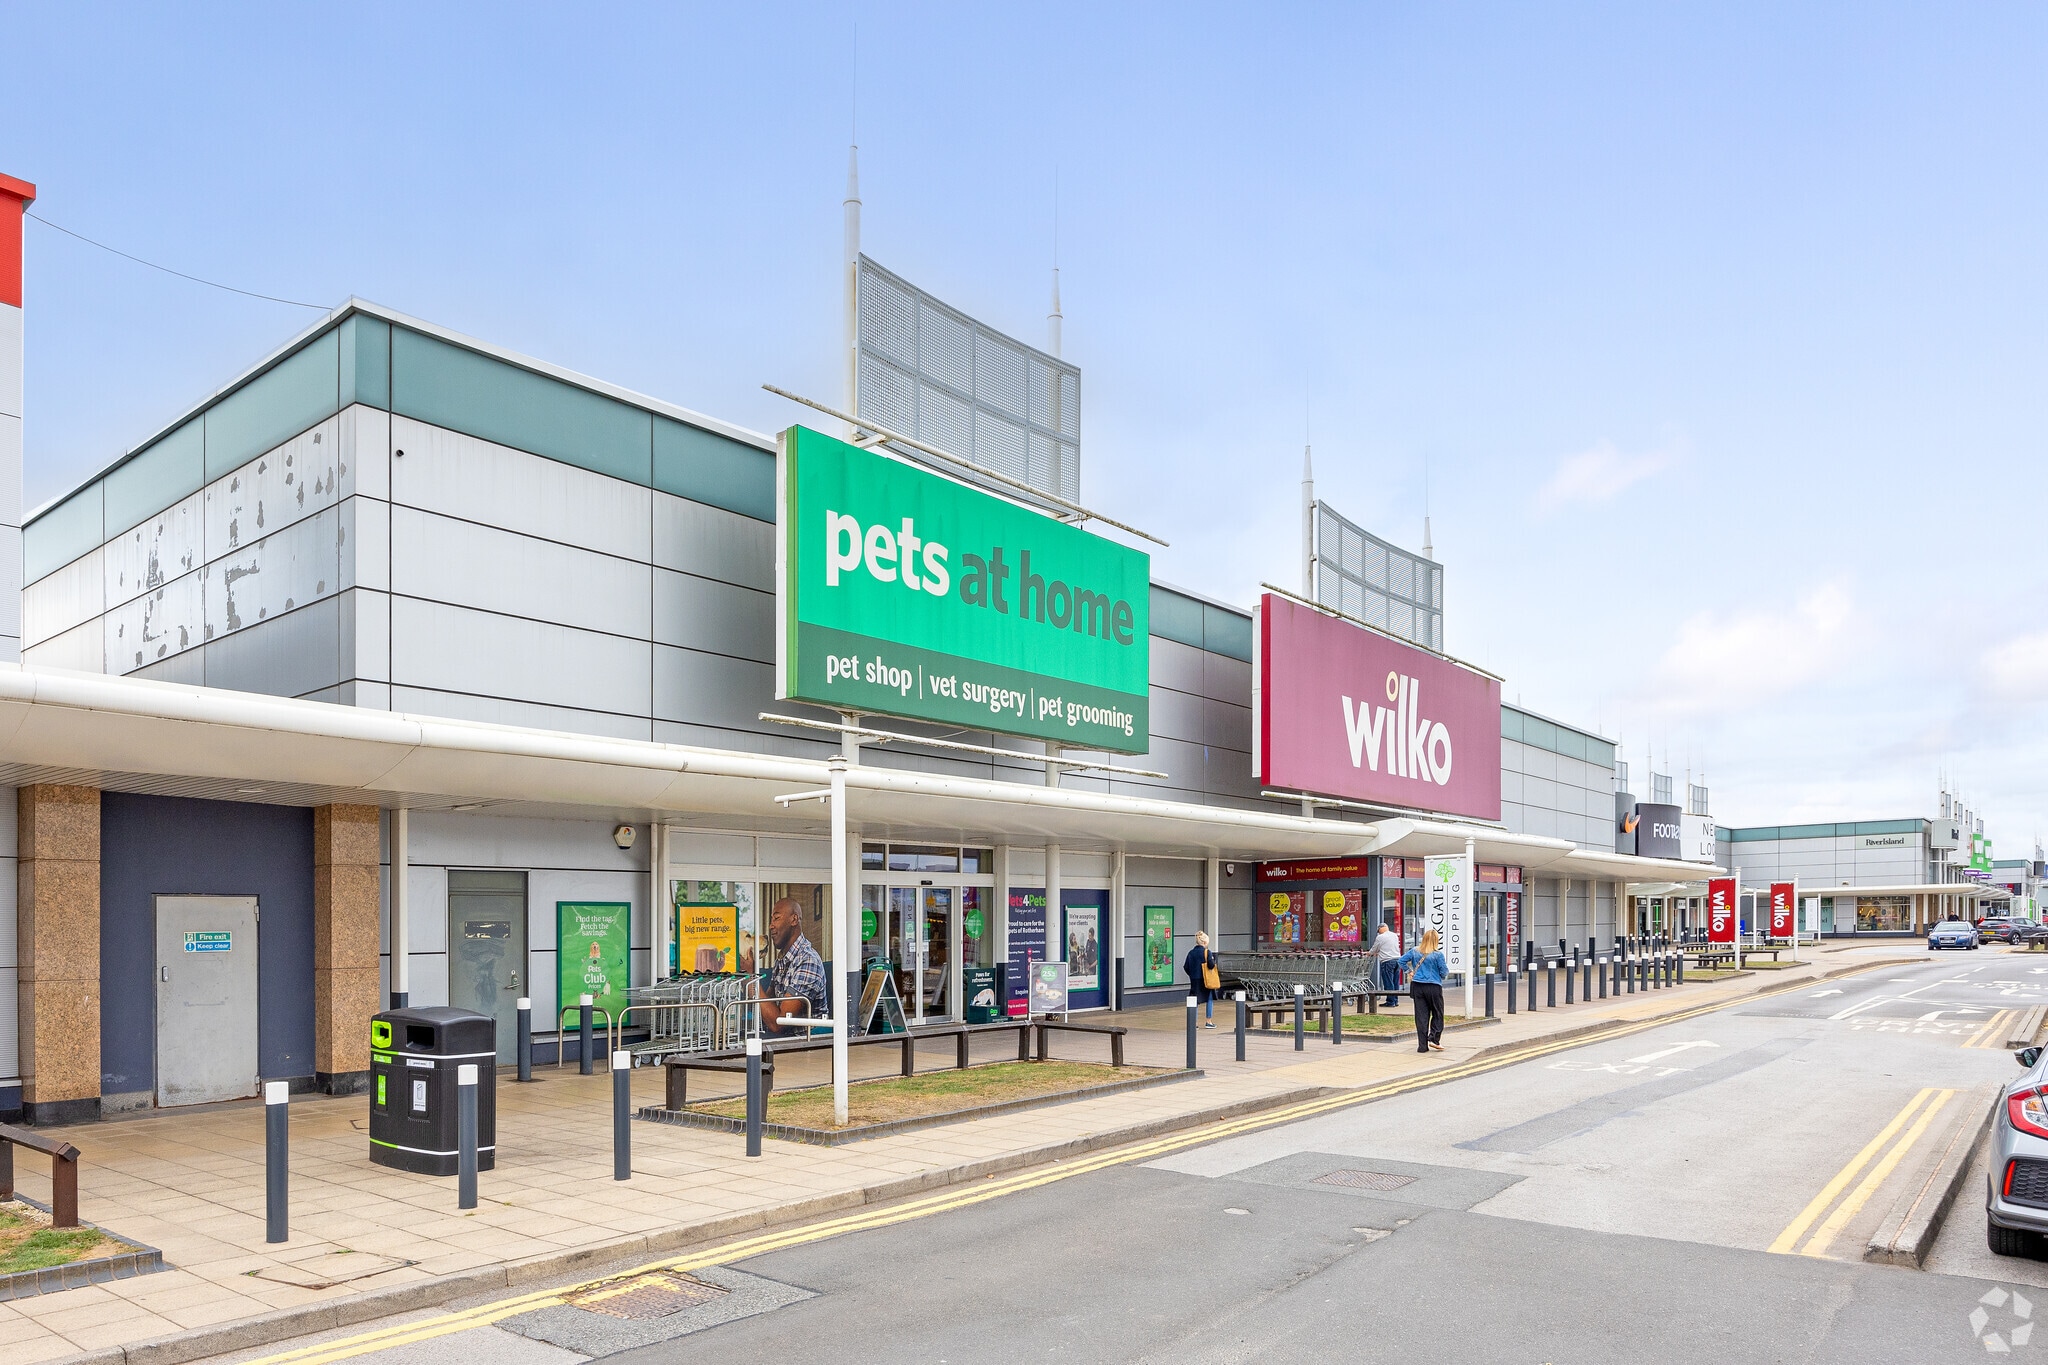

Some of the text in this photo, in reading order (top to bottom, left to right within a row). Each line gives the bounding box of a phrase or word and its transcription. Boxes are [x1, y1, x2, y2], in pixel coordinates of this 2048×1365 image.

[826, 509, 1134, 646] pets at home
[826, 655, 912, 696] pet shop
[929, 674, 1026, 717] vet surgery
[1039, 696, 1134, 736] pet grooming
[1341, 670, 1452, 786] wilko
[1702, 822, 1714, 837] NE
[1266, 866, 1288, 877] wilko
[692, 916, 708, 924] Little
[1712, 890, 1731, 932] wilko
[1773, 892, 1790, 928] wilko
[581, 929, 607, 937] savings.
[684, 925, 695, 934] big
[1451, 884, 1460, 964] SHOPPING
[584, 973, 606, 984] Club
[587, 965, 602, 973] Pets
[1544, 1060, 1694, 1076] EXIT
